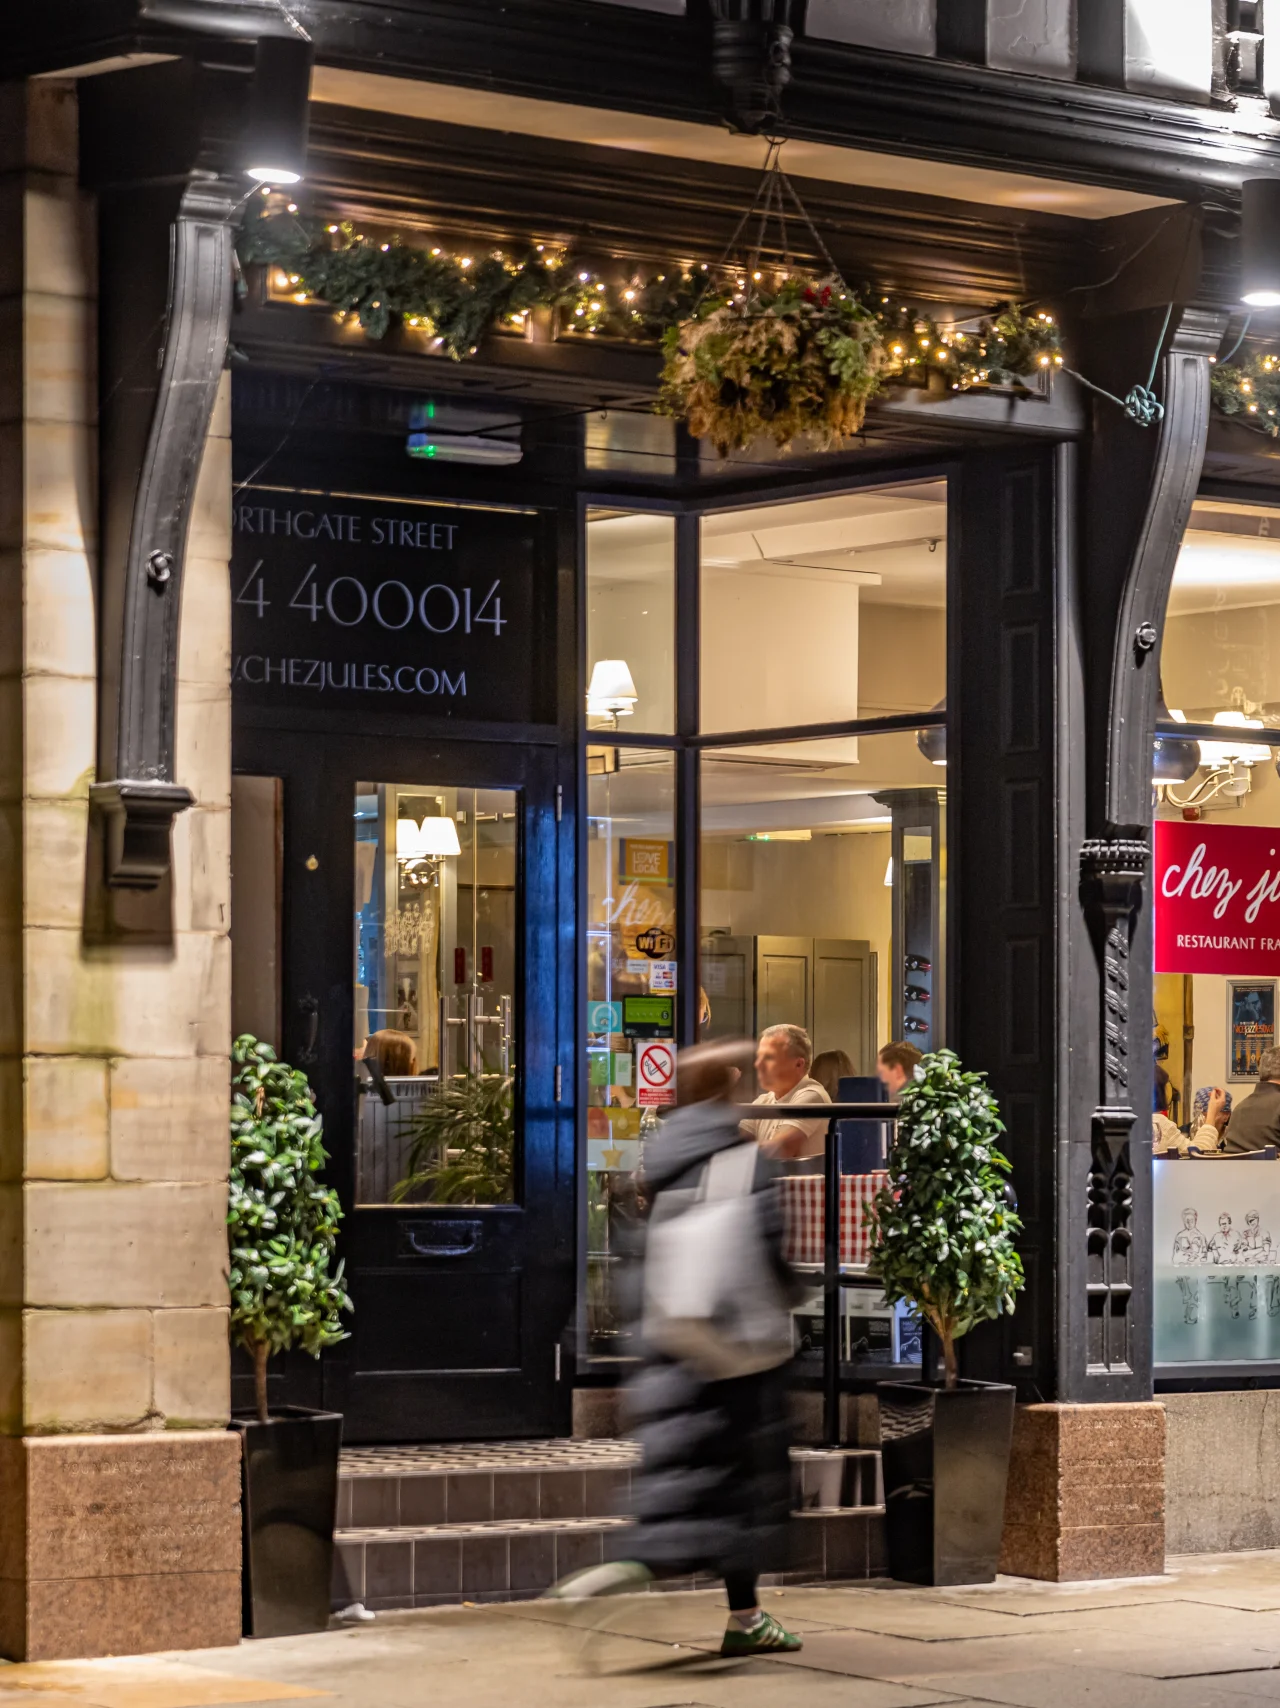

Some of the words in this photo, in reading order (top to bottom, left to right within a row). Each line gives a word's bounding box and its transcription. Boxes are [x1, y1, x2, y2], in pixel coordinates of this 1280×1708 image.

[371, 517, 459, 549] STREET
[236, 560, 271, 618] 4
[289, 564, 508, 636] 400014
[633, 851, 661, 864] LOVE
[633, 862, 661, 874] LOCAL
[1162, 843, 1242, 919] chez
[1177, 934, 1256, 950] RESTAURANT
